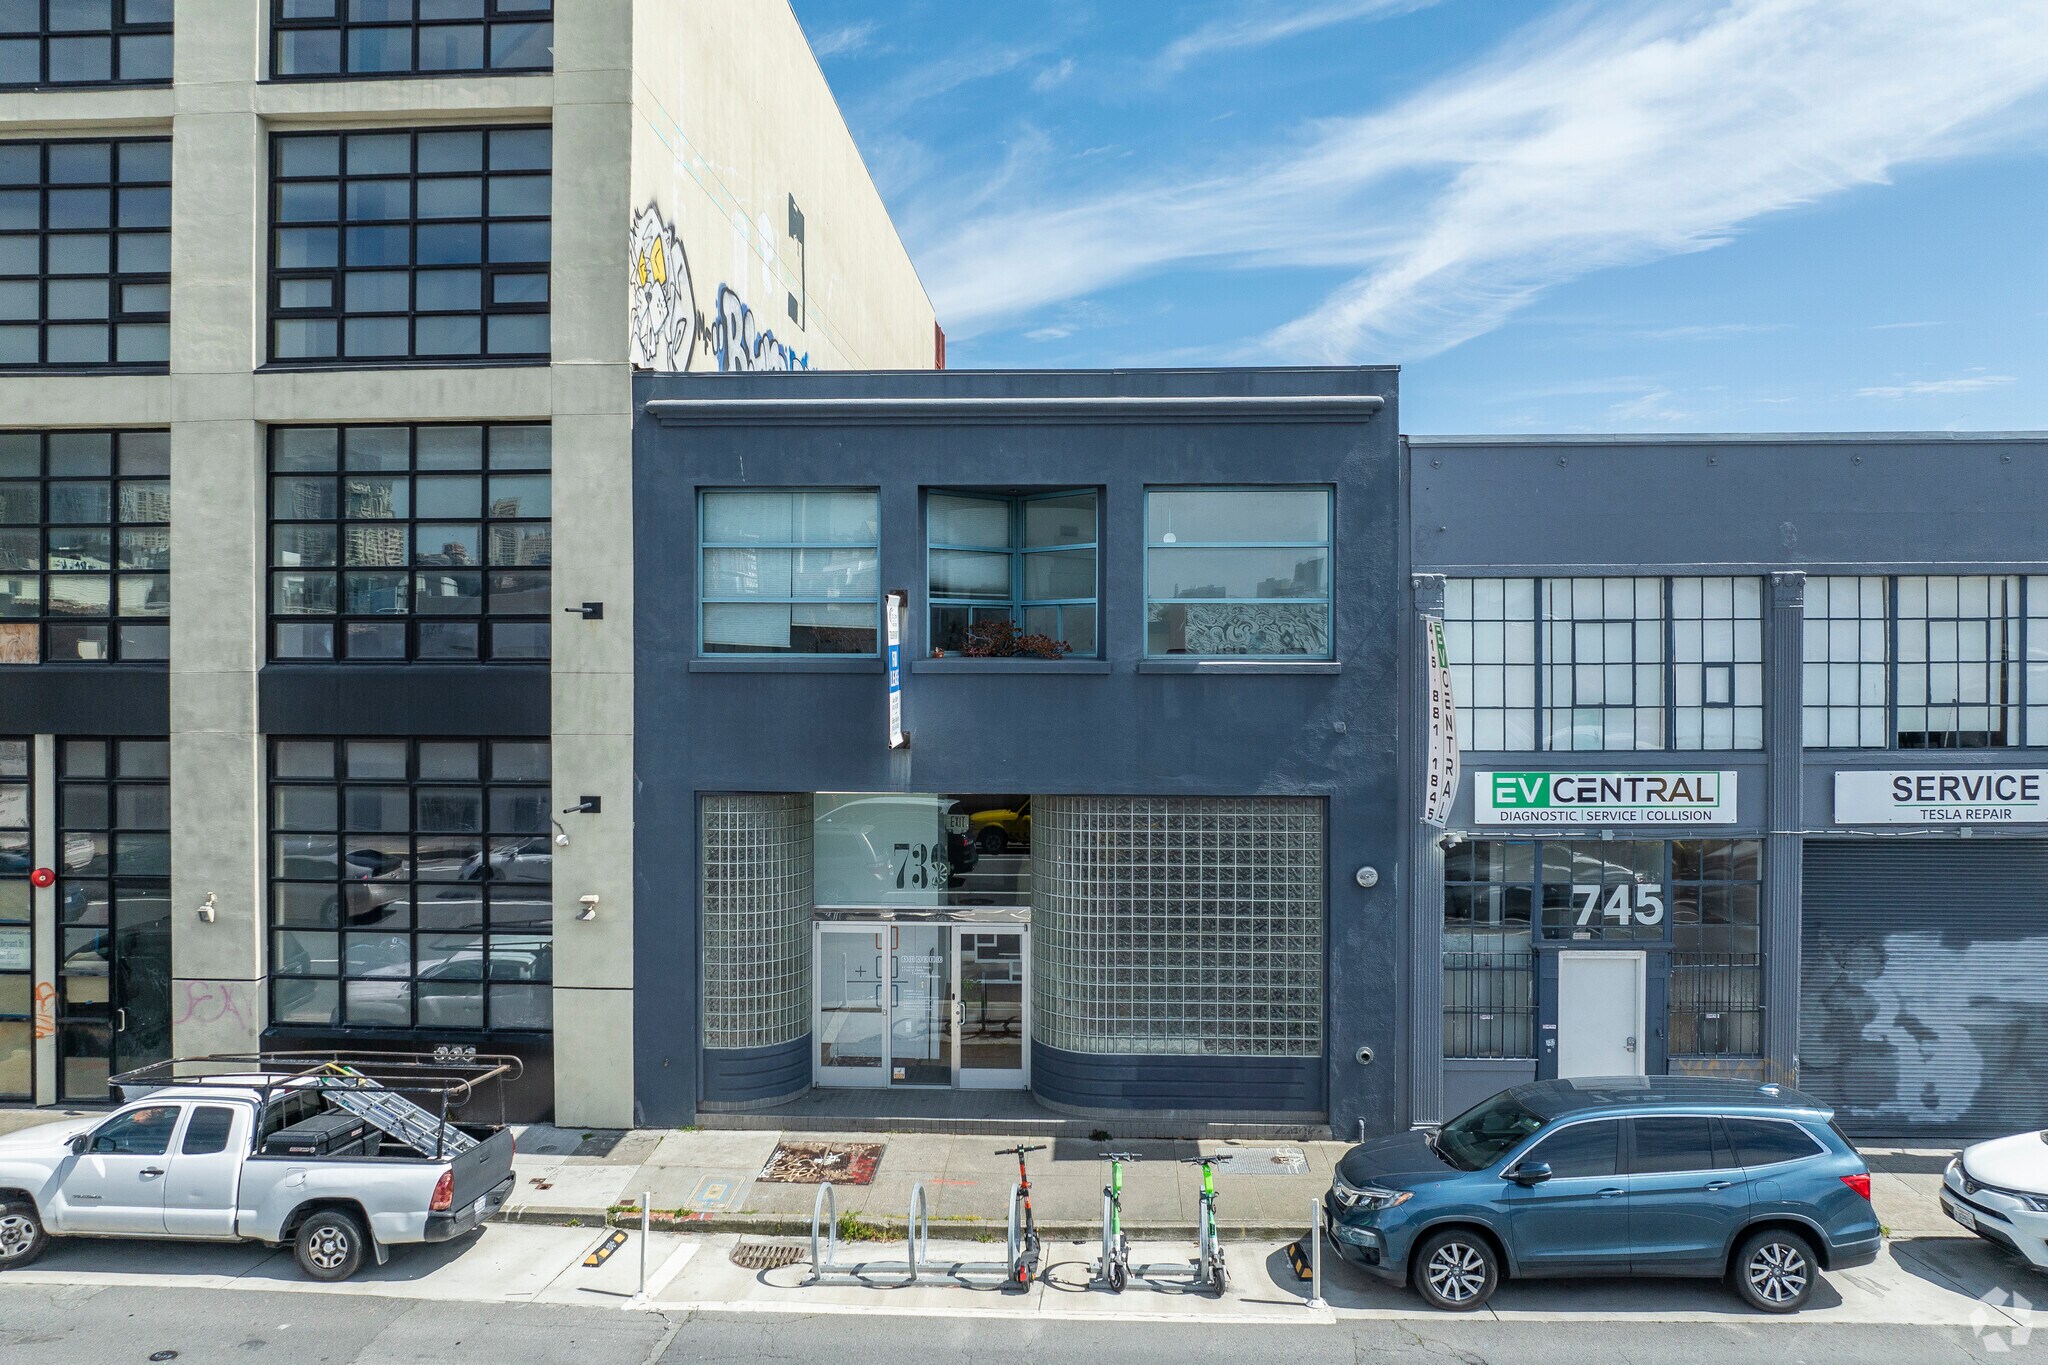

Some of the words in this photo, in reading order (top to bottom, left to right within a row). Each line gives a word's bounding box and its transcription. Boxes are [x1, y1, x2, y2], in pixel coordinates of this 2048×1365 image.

[1428, 622, 1440, 820] 415.881.1845
[1496, 777, 1544, 803] EV
[1553, 777, 1714, 803] CENTRAL
[1892, 775, 2040, 801] SERVICE
[950, 816, 966, 828] EXIT
[1500, 811, 1577, 821] DIAGNOSTIC
[1586, 811, 1637, 821] SERVICE
[1646, 810, 1712, 821] COLLISION
[1920, 809, 1962, 820] TESLA
[1966, 809, 2012, 820] REPAIR
[1572, 884, 1664, 925] 745
